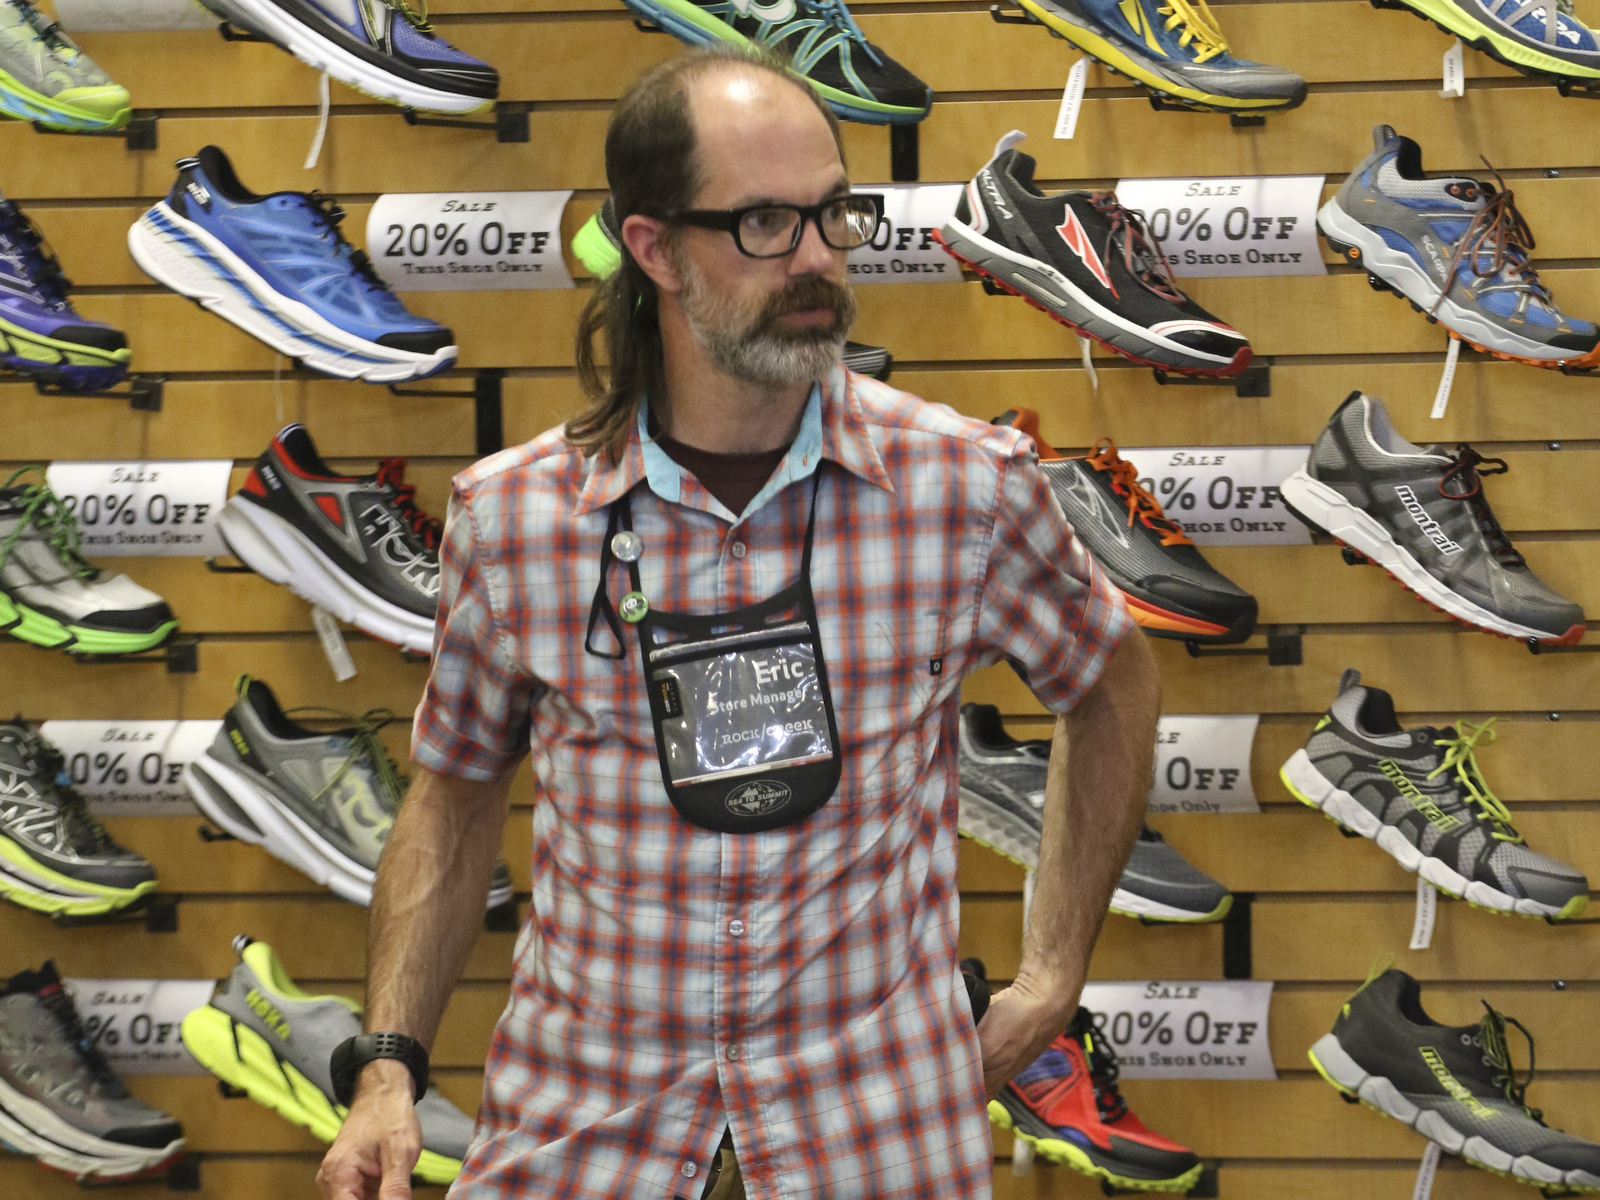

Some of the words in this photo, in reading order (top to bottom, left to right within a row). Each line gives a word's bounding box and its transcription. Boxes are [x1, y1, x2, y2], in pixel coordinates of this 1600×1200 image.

[981, 168, 1014, 220] ALTRA
[385, 223, 468, 256] 20%
[847, 263, 885, 274] HOE
[1394, 485, 1464, 556] montrail
[755, 657, 804, 684] Eric
[70, 752, 129, 785] 0%
[140, 752, 185, 785] OF
[728, 797, 743, 806] SEA
[758, 789, 789, 801] SUMMIT
[1377, 758, 1463, 834] montrail
[1418, 1045, 1502, 1119] montrail
